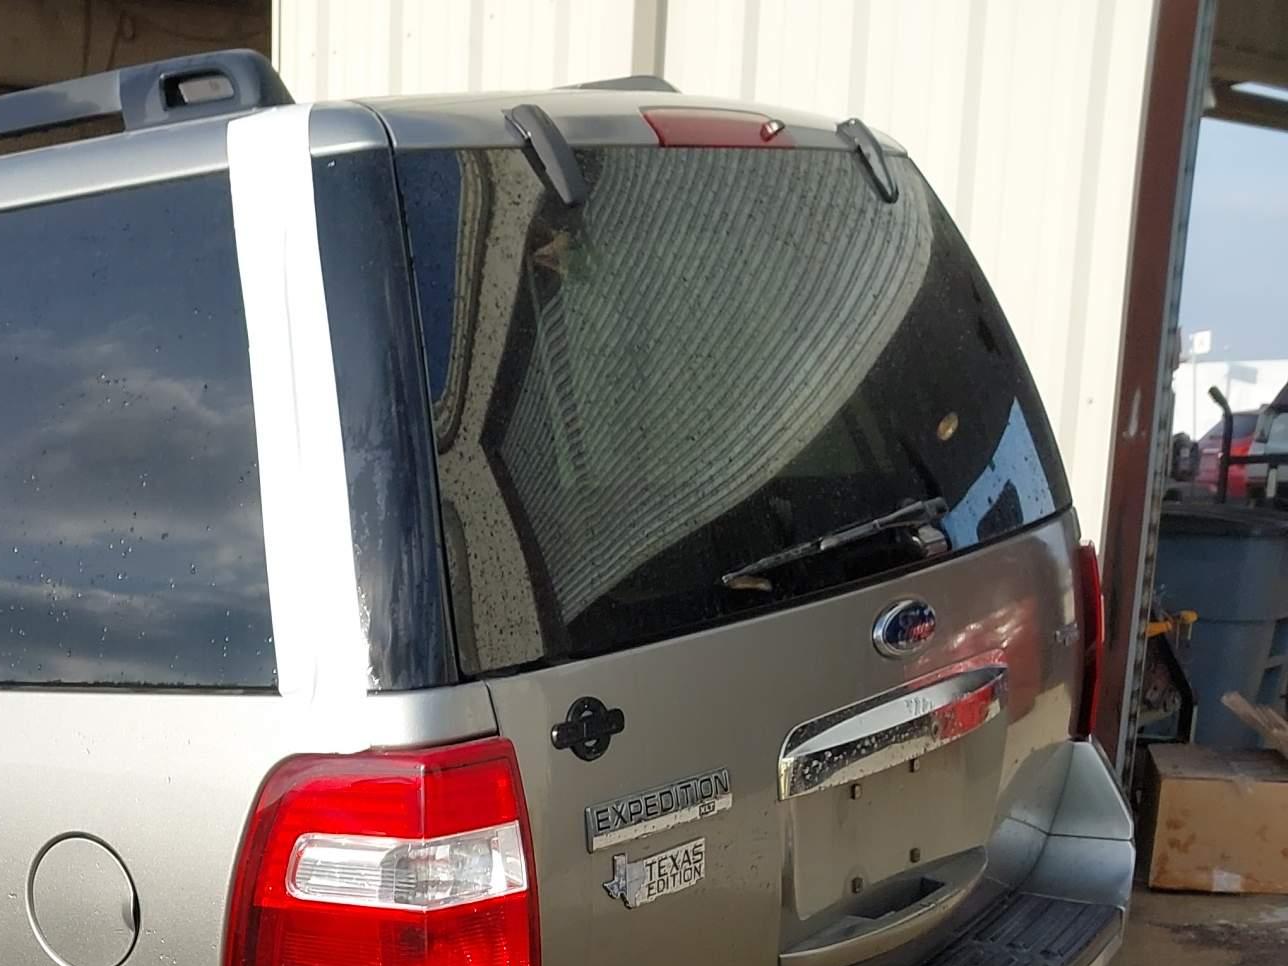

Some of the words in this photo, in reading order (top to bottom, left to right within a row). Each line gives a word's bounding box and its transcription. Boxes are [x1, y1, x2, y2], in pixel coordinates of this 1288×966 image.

[595, 771, 730, 832] EXPEDITION
[645, 843, 704, 882] TEXAS
[646, 864, 703, 897] EDITION
